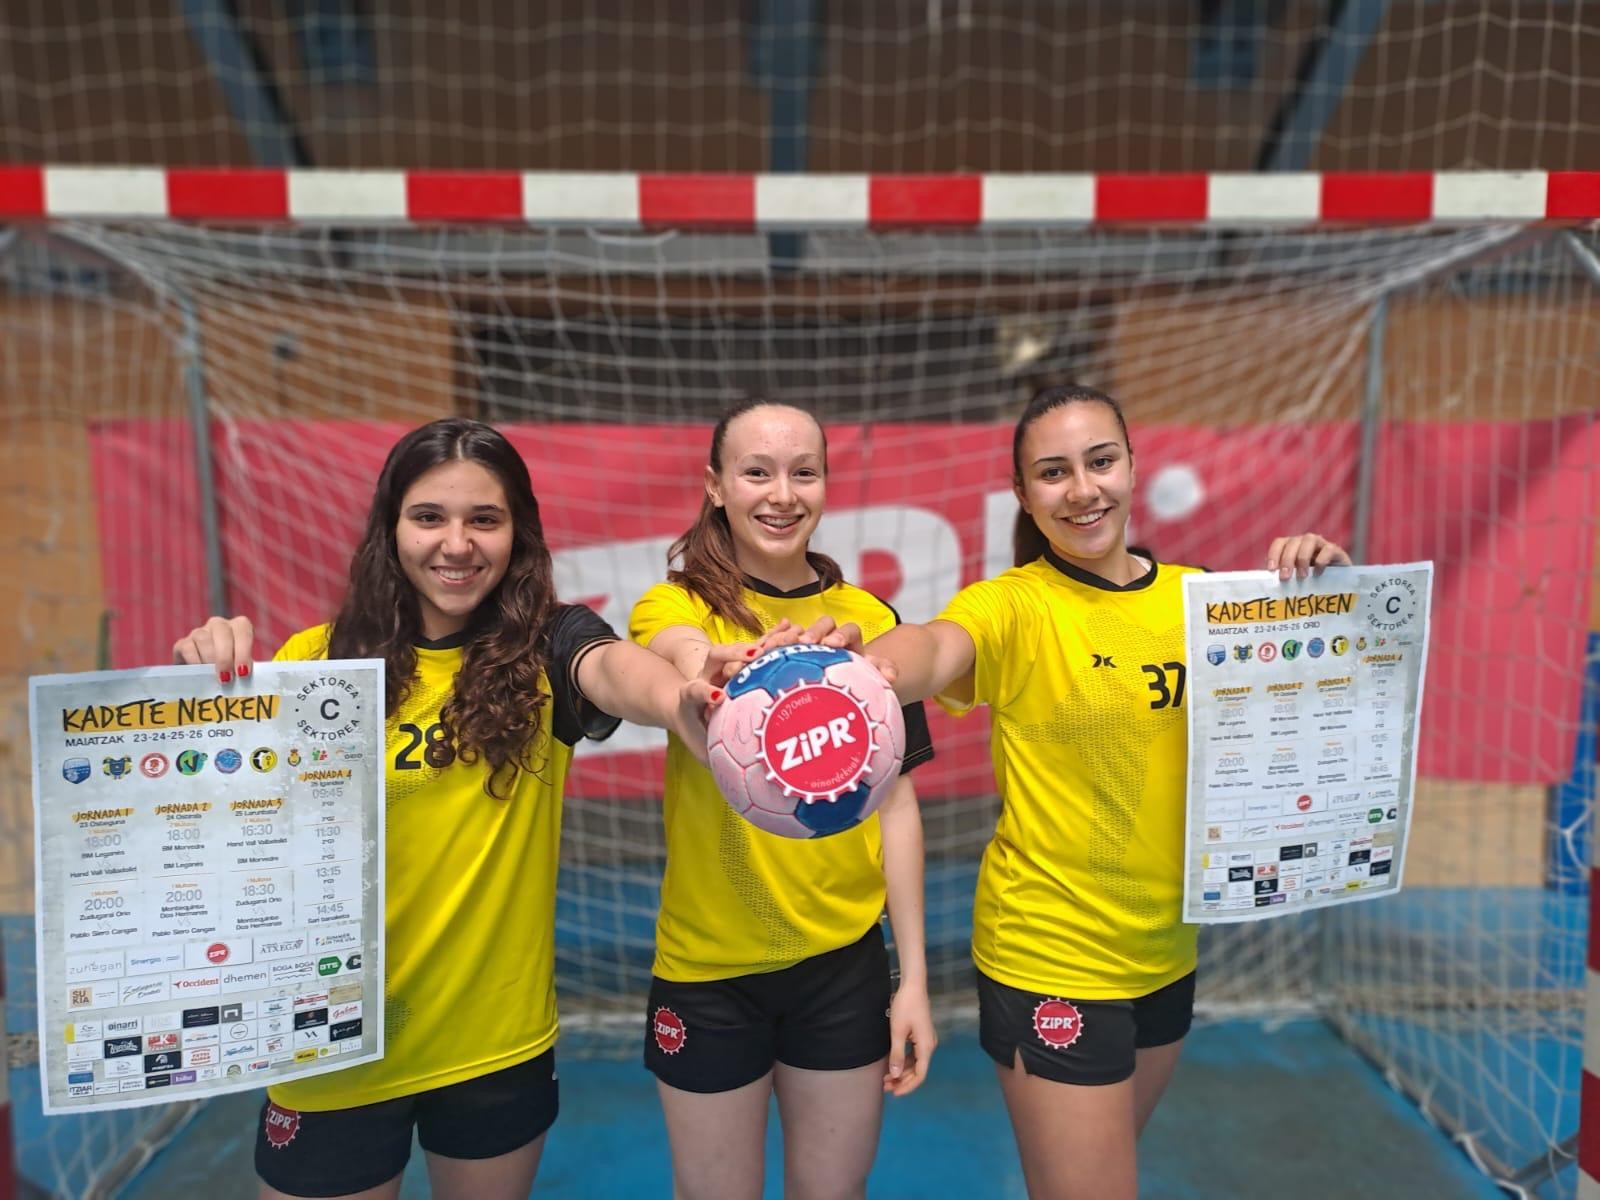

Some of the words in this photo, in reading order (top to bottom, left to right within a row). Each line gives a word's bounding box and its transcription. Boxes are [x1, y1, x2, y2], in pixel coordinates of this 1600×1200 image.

[1206, 597, 1277, 623] KADETE
[1284, 593, 1353, 617] NESKEN
[1386, 596, 1401, 614] C
[1367, 613, 1414, 631] SEKTOREA
[1208, 627, 1248, 636] MAIATZAK
[296, 676, 360, 701] SEKTOREA
[1141, 661, 1186, 710] 37
[62, 698, 166, 731] KADETE
[178, 694, 274, 723] NESKEN
[319, 698, 341, 721] C
[297, 718, 360, 741] SEKTOREA
[65, 734, 125, 747] MAIATZAK
[133, 730, 203, 743] 23-24-25-26
[208, 728, 234, 739] ORIO
[775, 714, 857, 771] ZiPR
[395, 723, 456, 770] 28
[304, 770, 343, 781] JORNADA
[312, 787, 344, 799] 09:45
[156, 803, 199, 815] JORNADA
[232, 799, 273, 811] JORNADA
[75, 809, 121, 822] JORNADA
[167, 828, 201, 841] 18:00
[241, 824, 273, 836] 16:30
[84, 834, 122, 848] 18:00
[316, 866, 341, 878] 13:15
[166, 889, 203, 903] 20:00
[242, 884, 275, 896] 18:30
[84, 897, 124, 912] 20:00
[316, 903, 343, 915] 14:45
[182, 978, 219, 989] Occident
[223, 971, 267, 984] dhemen
[72, 990, 86, 998] SU
[72, 997, 90, 1005] KIA
